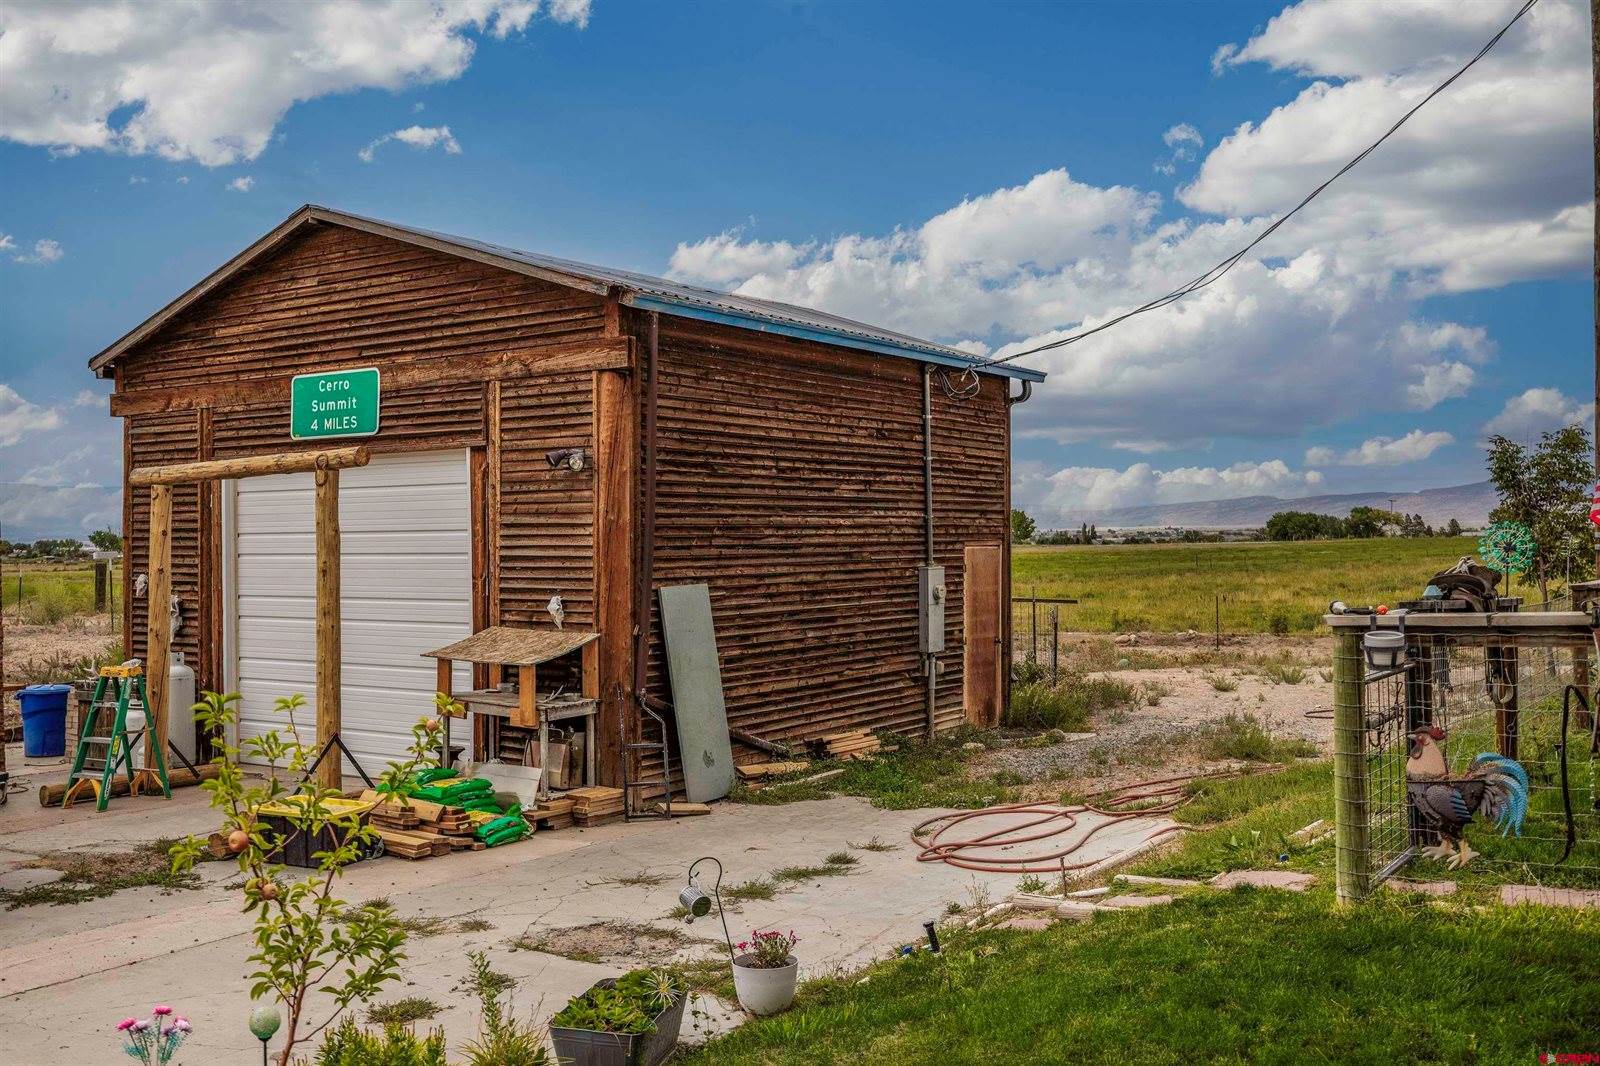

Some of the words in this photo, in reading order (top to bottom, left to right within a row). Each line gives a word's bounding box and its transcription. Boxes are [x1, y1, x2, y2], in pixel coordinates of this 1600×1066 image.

[319, 380, 350, 392] Cerro
[311, 396, 357, 412] Summit
[310, 418, 319, 430] 4
[324, 416, 358, 430] MILES
